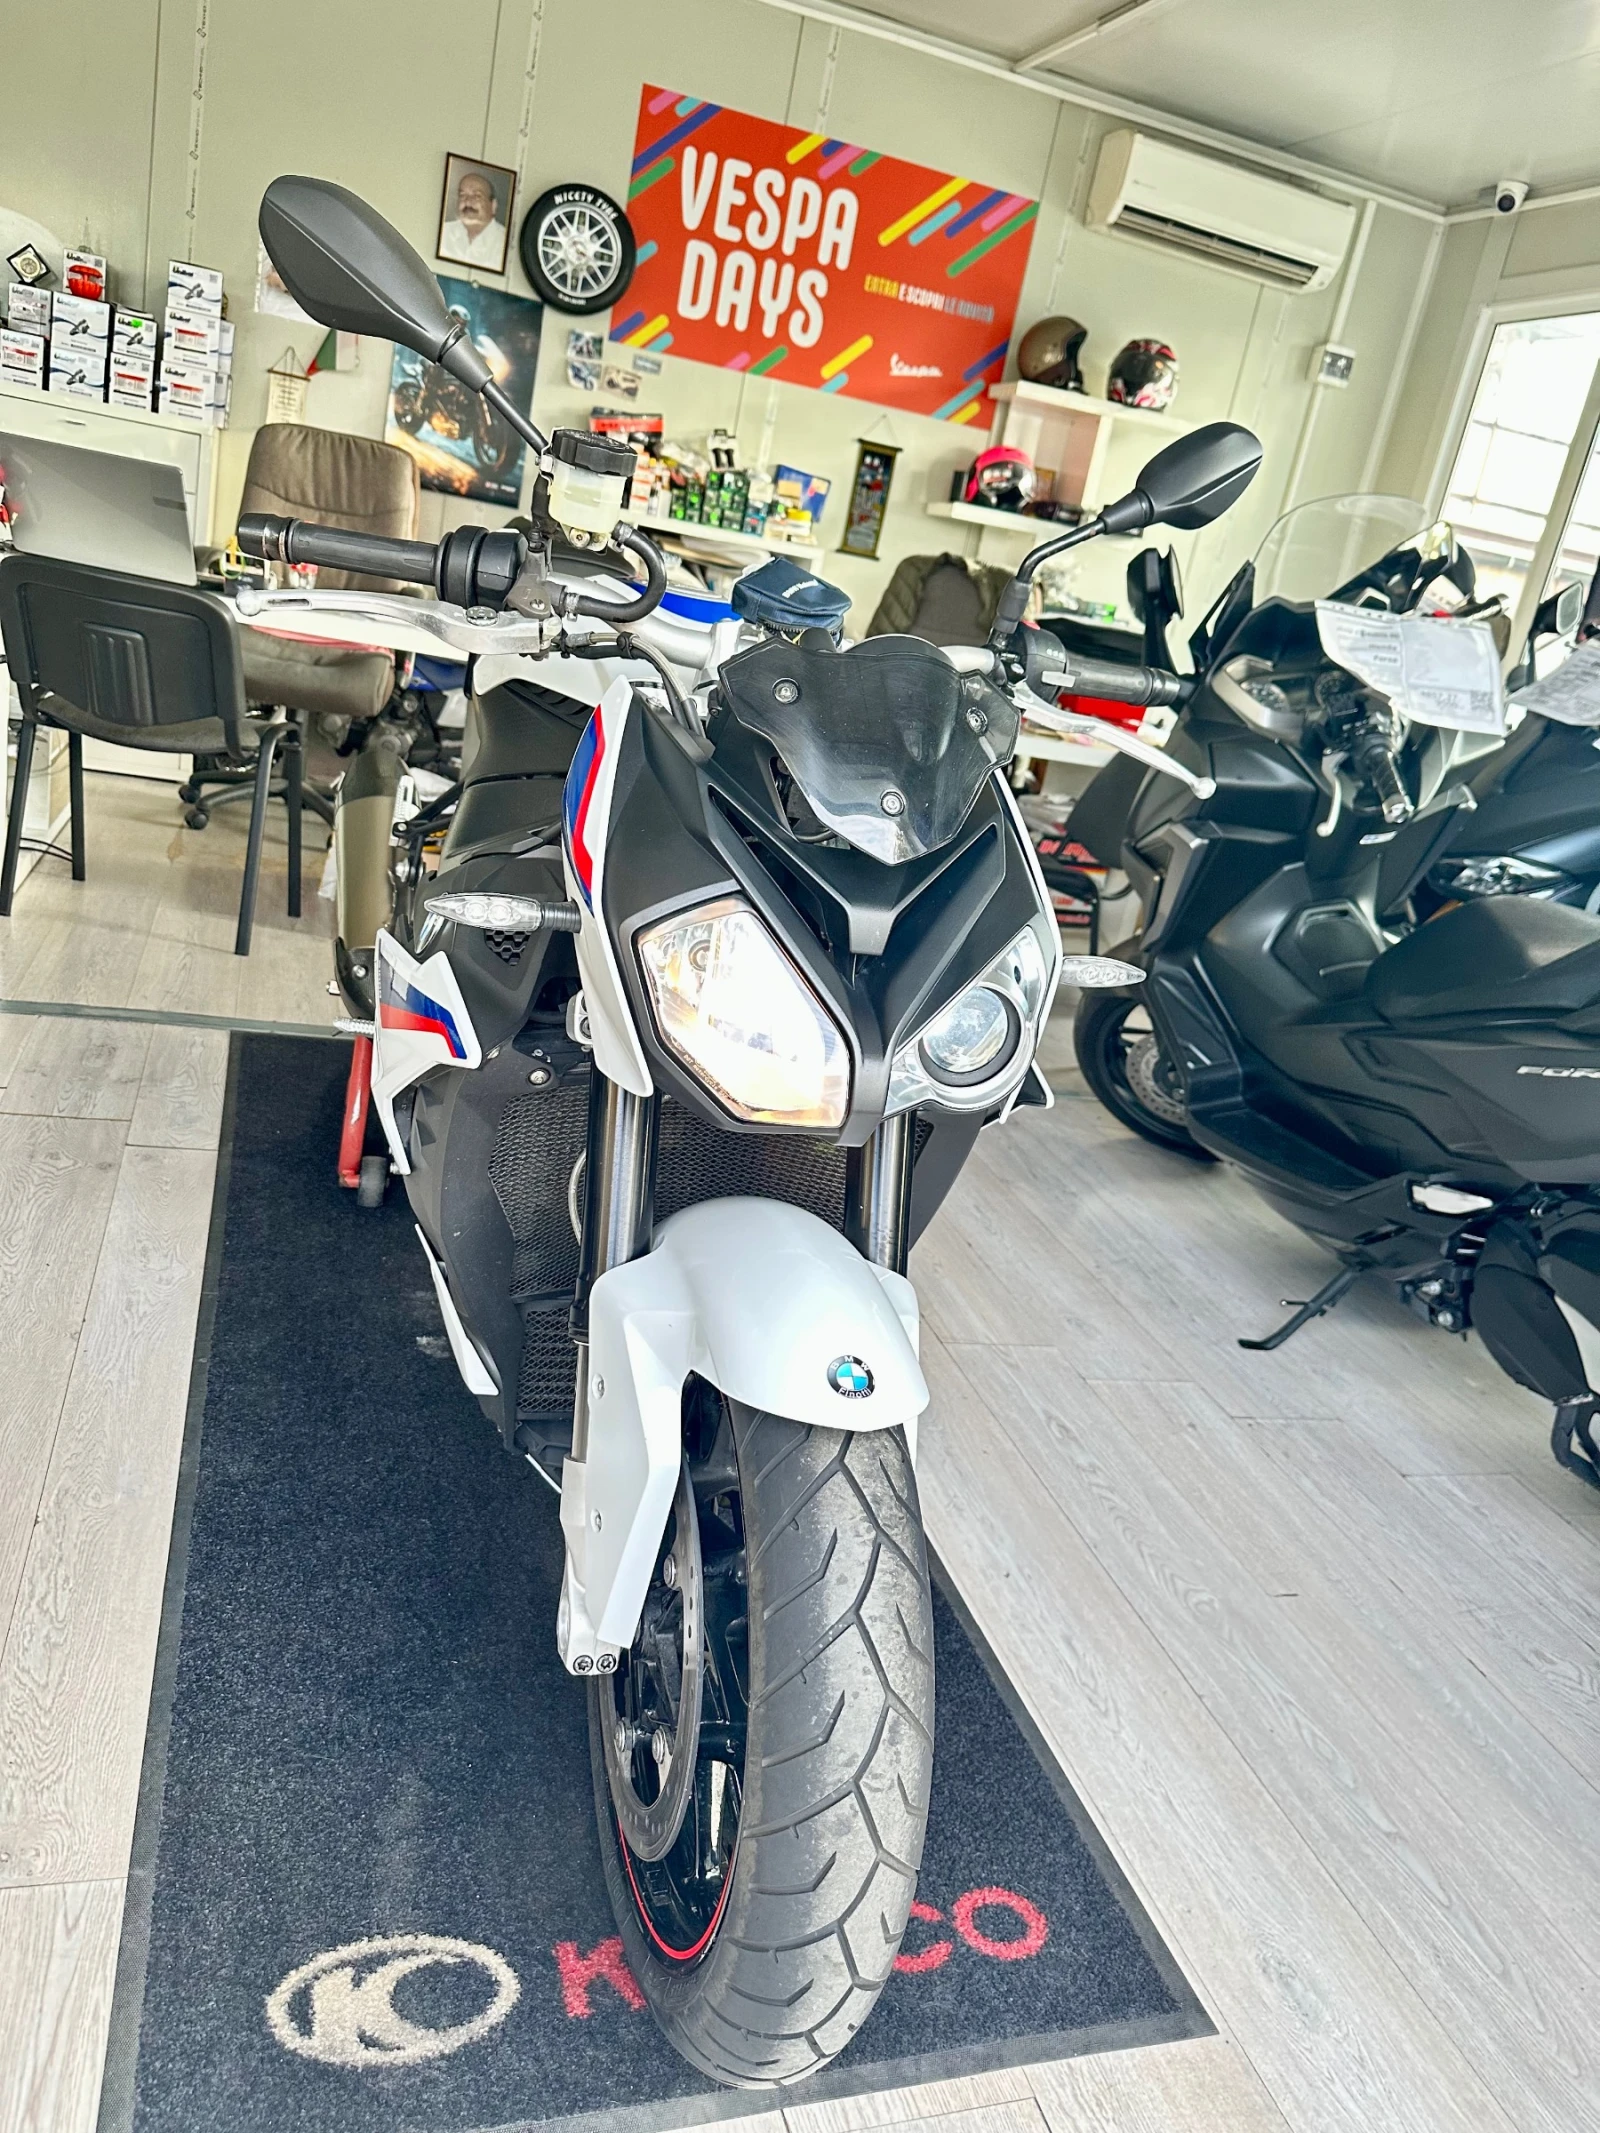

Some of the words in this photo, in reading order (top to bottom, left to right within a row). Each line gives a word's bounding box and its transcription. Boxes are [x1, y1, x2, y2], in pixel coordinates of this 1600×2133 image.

[681, 145, 859, 271] VESPA
[677, 239, 828, 348] DAYS
[830, 1354, 870, 1371] BMW
